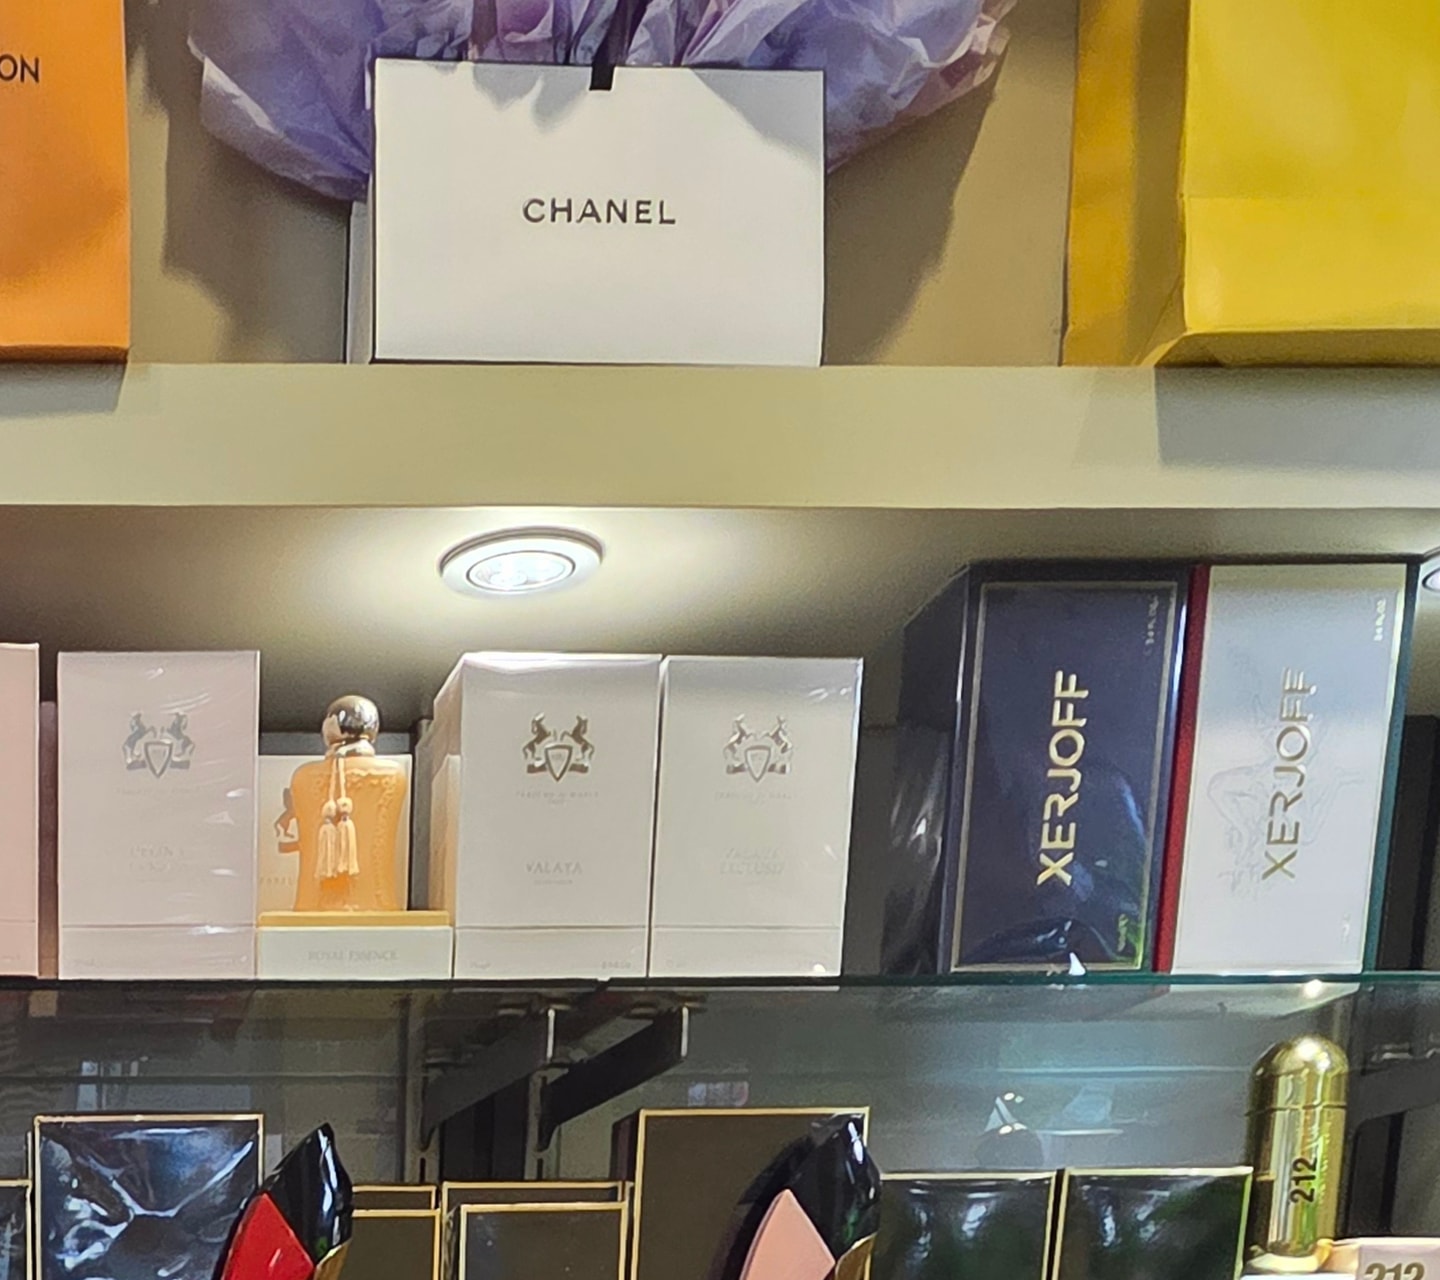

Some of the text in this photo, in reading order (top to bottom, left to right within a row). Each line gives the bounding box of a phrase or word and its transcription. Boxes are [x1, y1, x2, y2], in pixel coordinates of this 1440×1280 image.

[521, 197, 677, 227] CHANEL
[1036, 669, 1089, 887] XERJOFF
[1261, 667, 1317, 881] XERJOFF
[525, 862, 584, 876] VALAYA
[1289, 1156, 1319, 1204] 212
